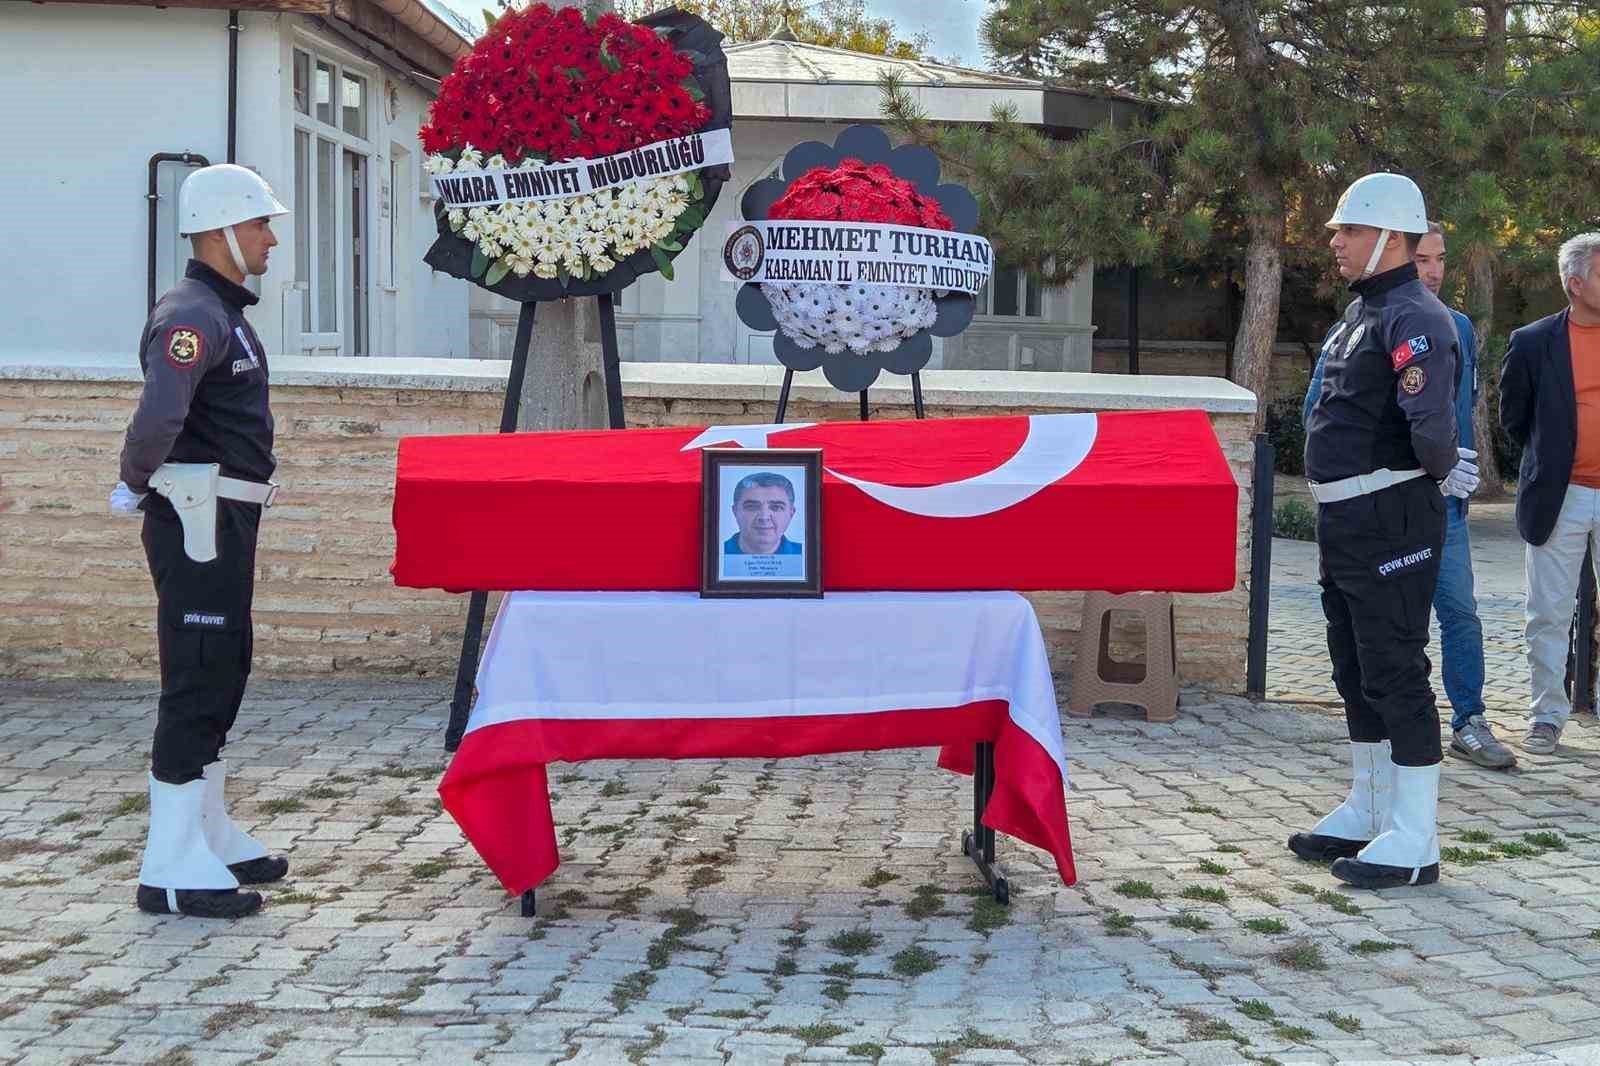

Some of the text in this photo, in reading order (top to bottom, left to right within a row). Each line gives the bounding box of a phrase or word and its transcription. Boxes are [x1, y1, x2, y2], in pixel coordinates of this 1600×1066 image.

[504, 166, 580, 197] EMNİYET
[588, 136, 705, 188] MÜDÜRLÜĞÜ
[766, 227, 881, 253] MEHMET
[889, 231, 989, 265] TURHAN
[764, 258, 833, 281] KARAMAN
[836, 253, 852, 282] İL
[857, 255, 927, 286] EMNİYET
[1403, 548, 1432, 566] KUVVET
